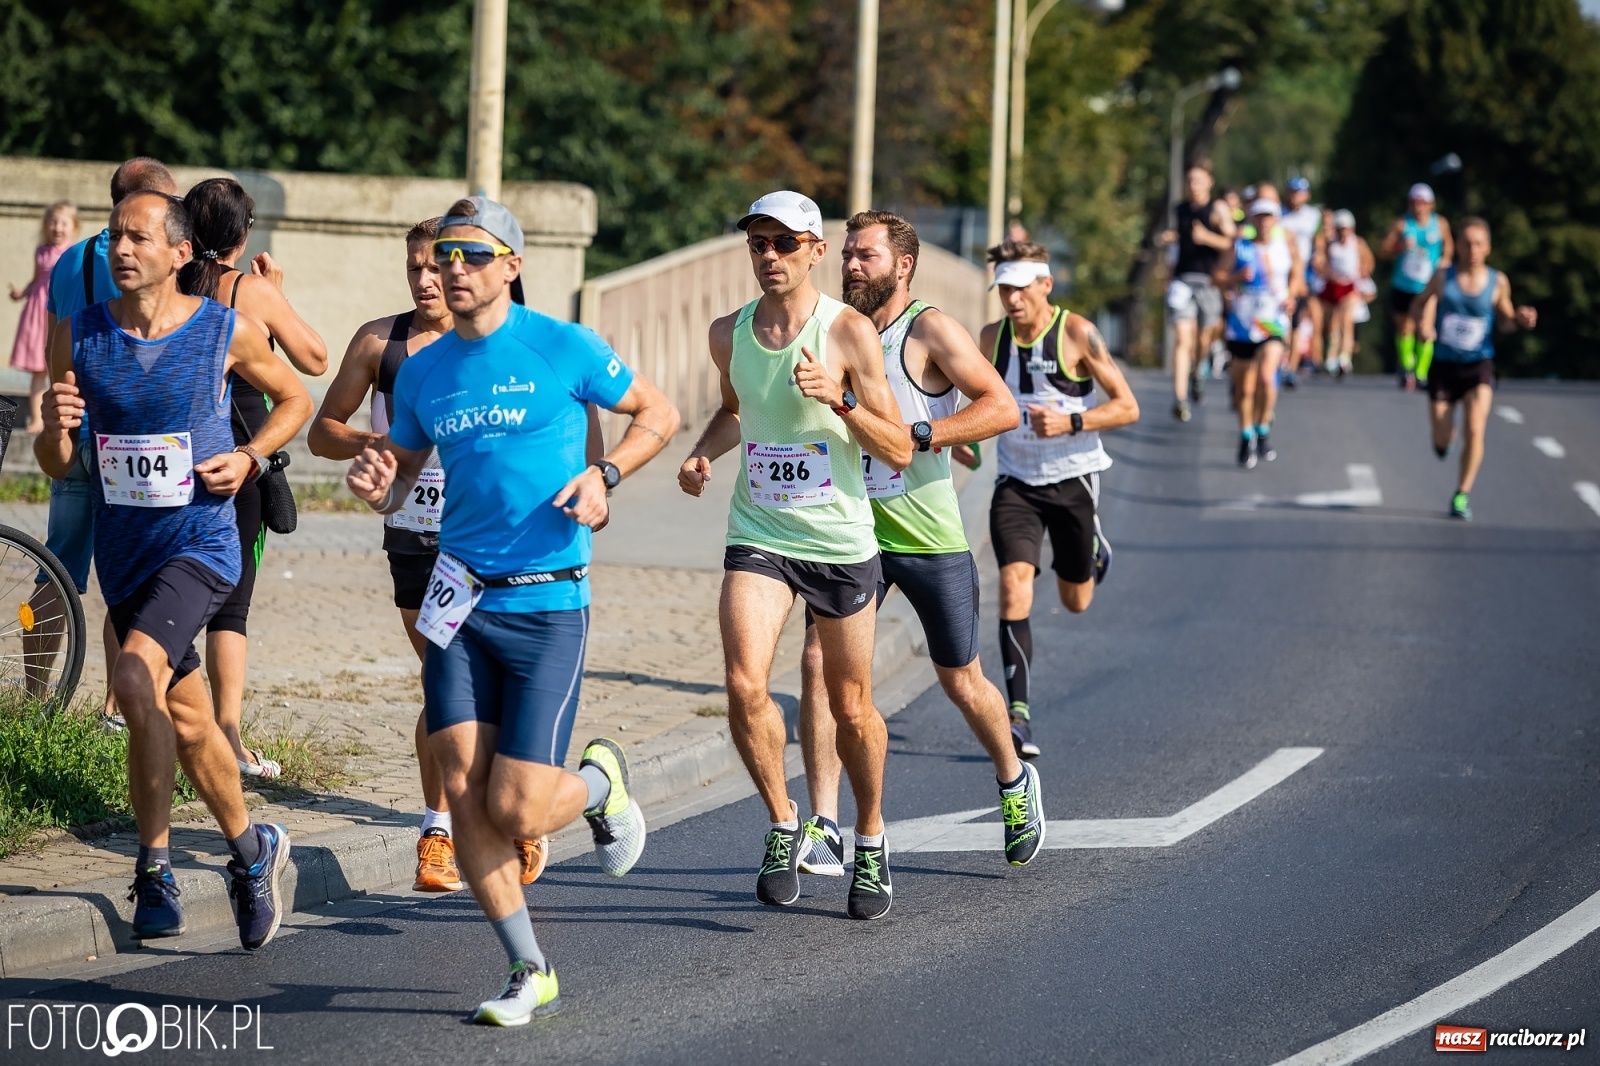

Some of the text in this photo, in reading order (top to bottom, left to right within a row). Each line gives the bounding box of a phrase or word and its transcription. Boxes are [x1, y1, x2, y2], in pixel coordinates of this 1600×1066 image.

[433, 404, 527, 439] KRAKÓW
[125, 455, 168, 478] 104
[768, 460, 810, 482] 286
[413, 485, 445, 507] 29
[507, 572, 556, 586] CANYON
[1006, 829, 1037, 852] BROOKS
